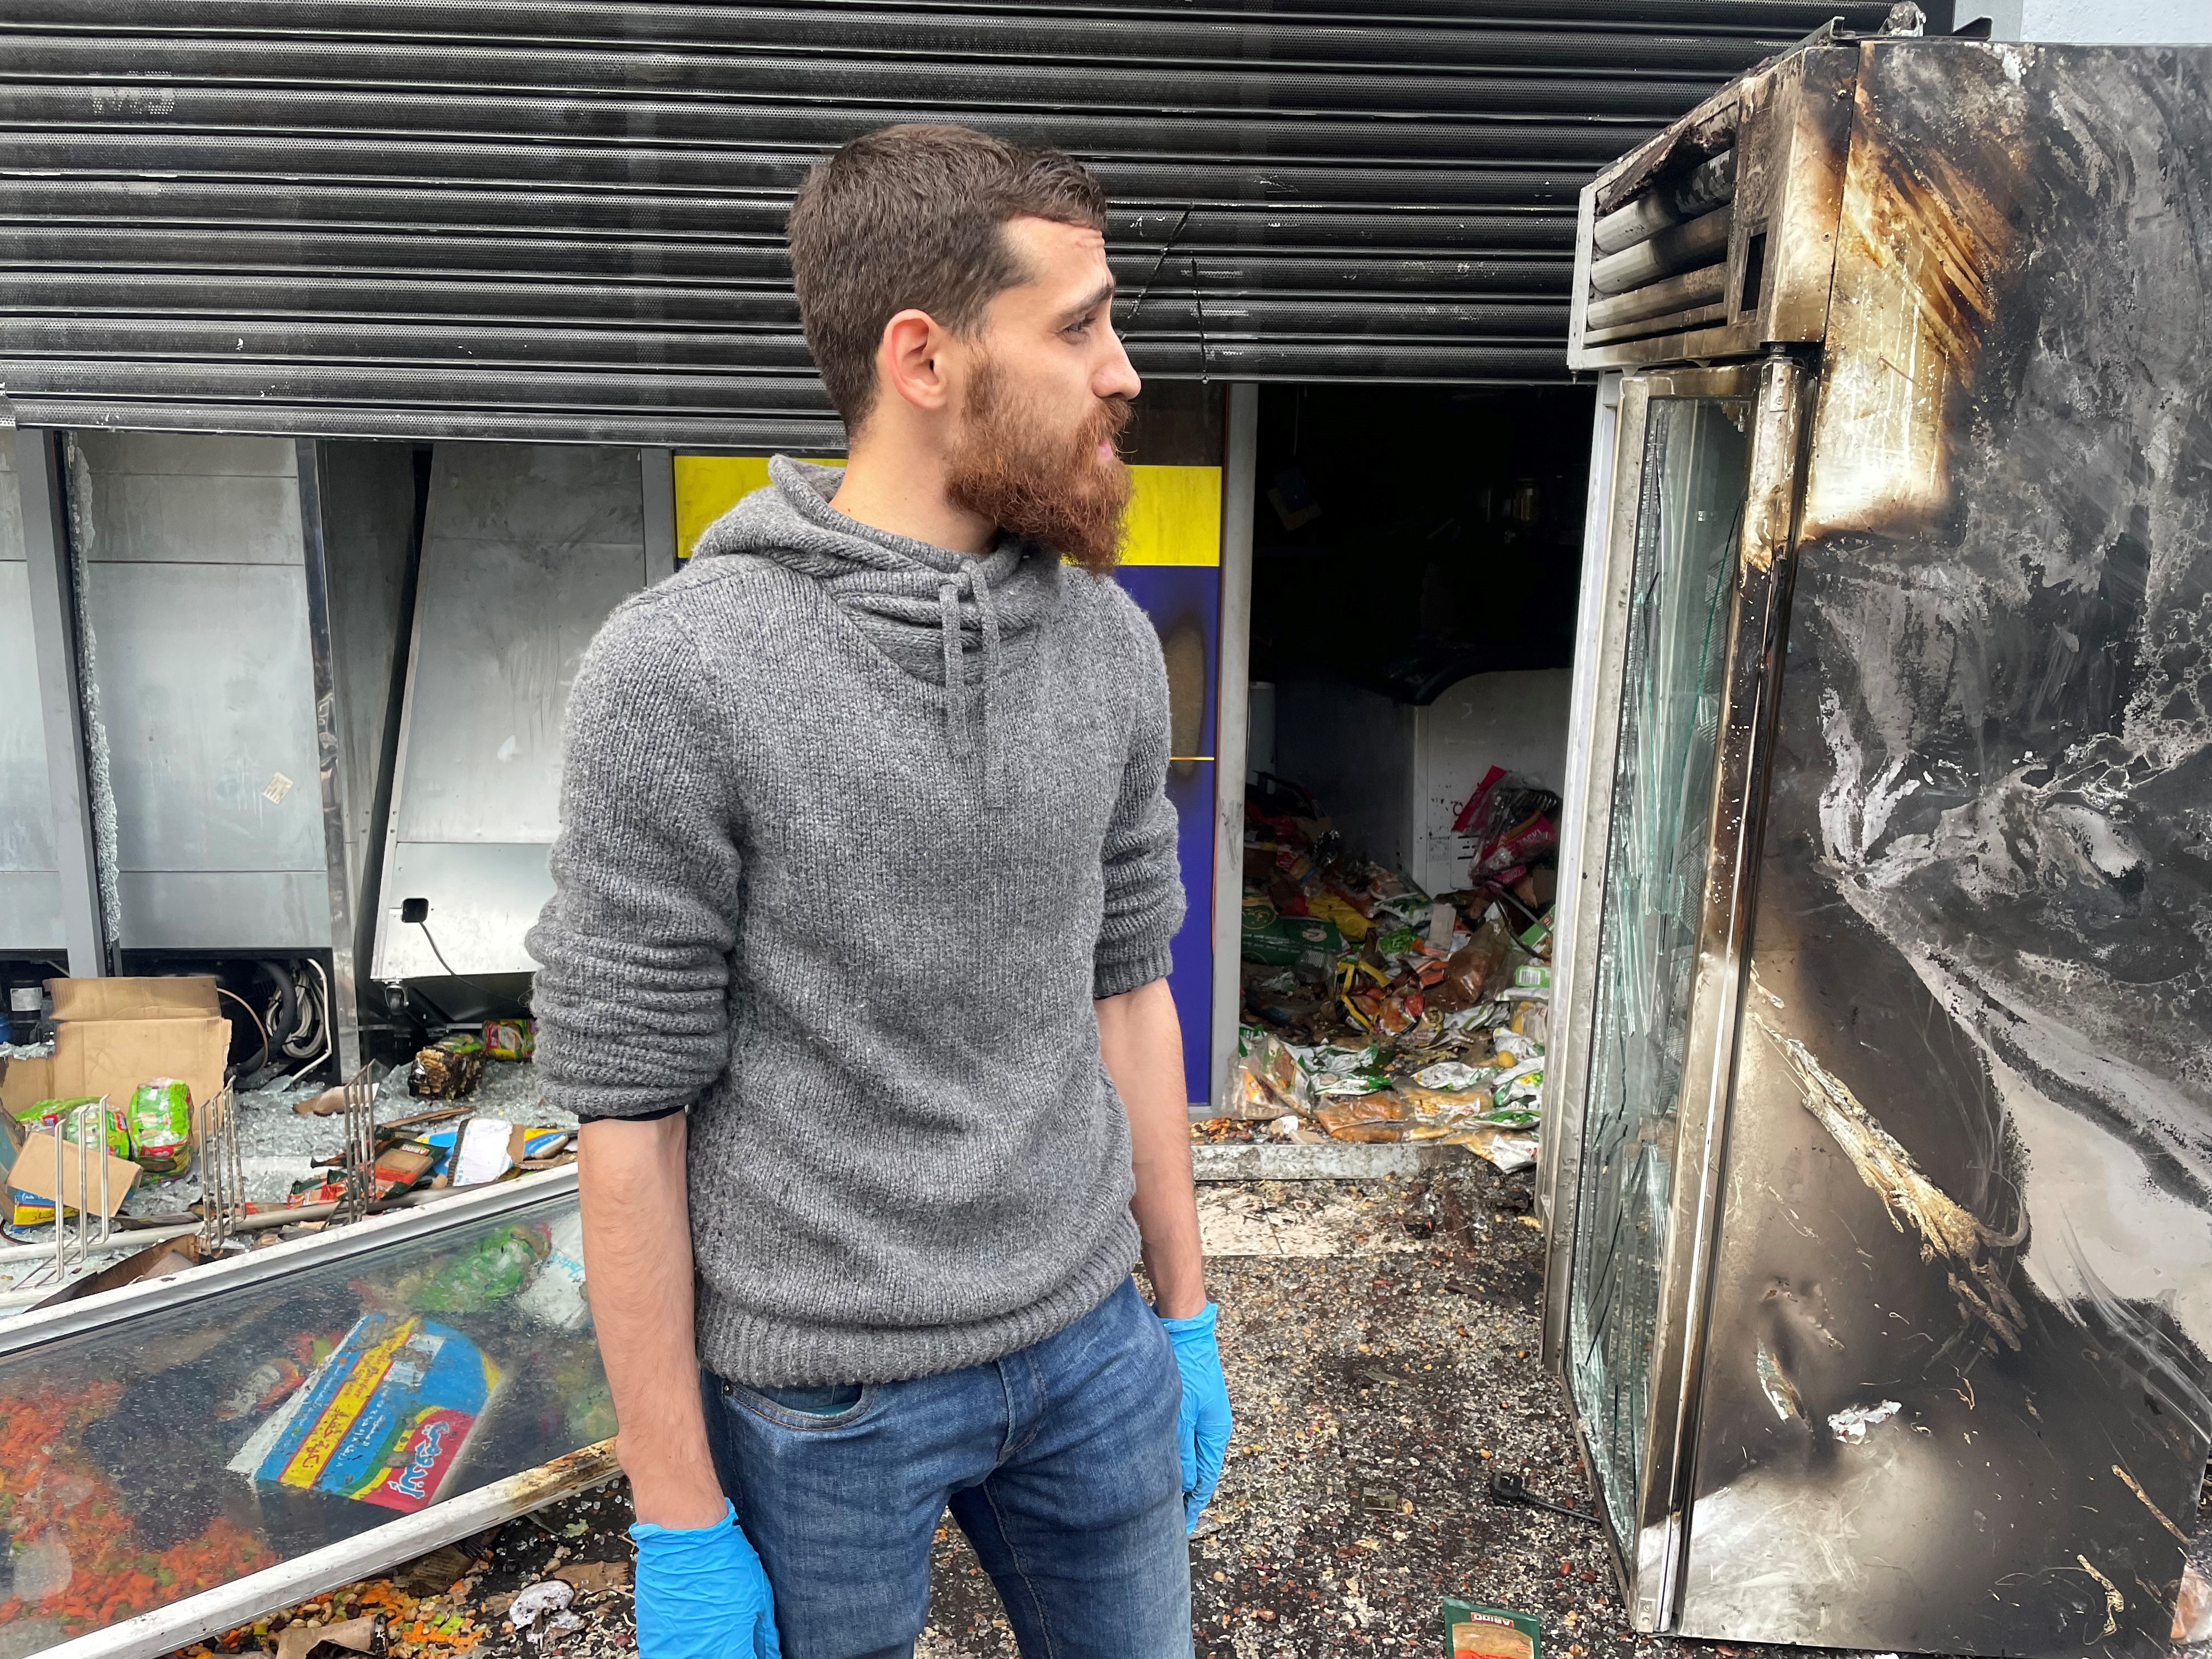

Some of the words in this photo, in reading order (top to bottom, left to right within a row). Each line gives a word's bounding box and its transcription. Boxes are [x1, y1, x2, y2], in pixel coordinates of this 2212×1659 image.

[302, 1440, 329, 1468] نكهة
[387, 1421, 450, 1499] إندومي
[1474, 1614, 1511, 1626] ABIDO
